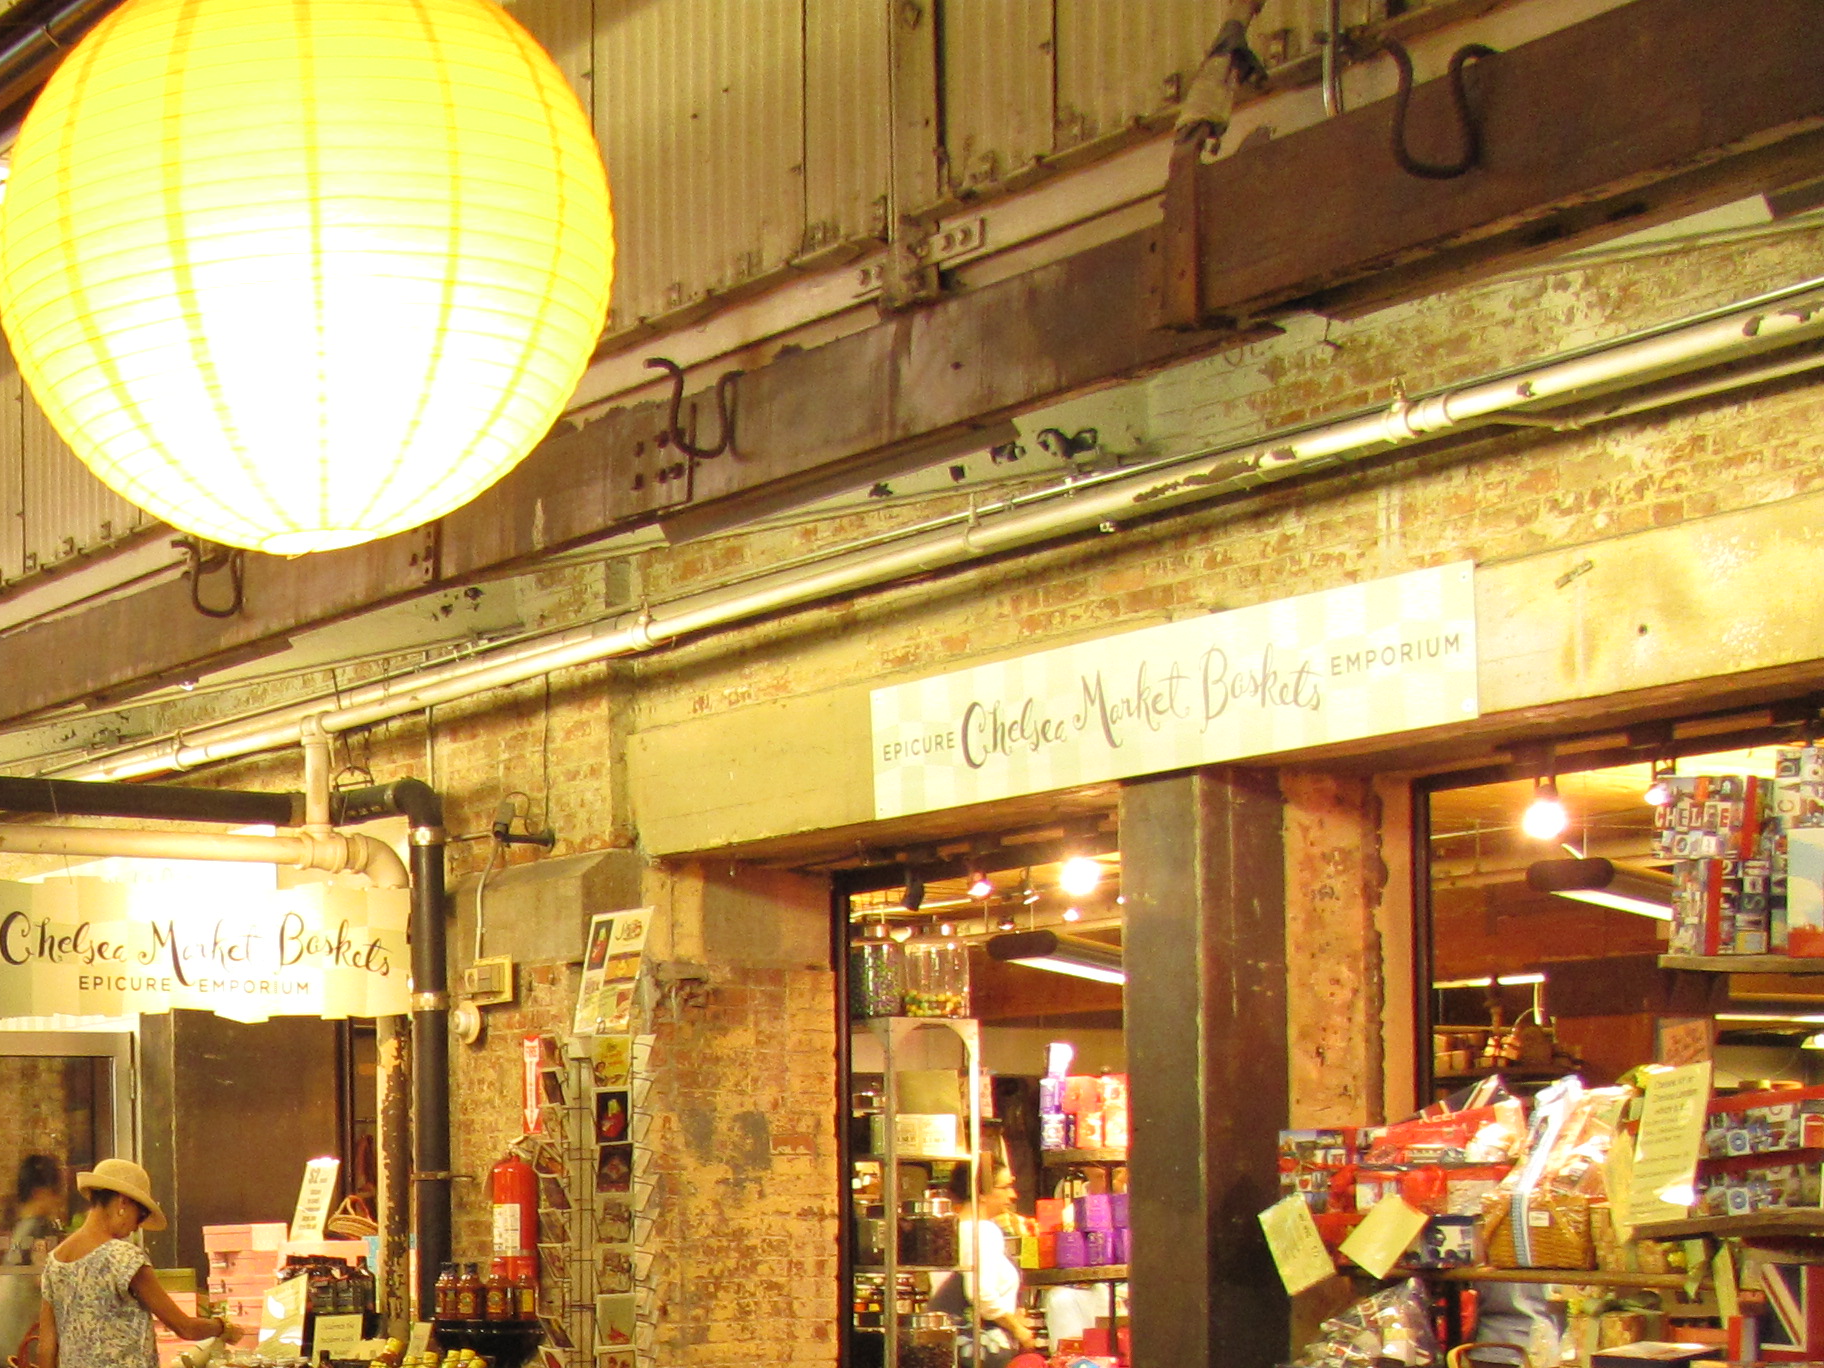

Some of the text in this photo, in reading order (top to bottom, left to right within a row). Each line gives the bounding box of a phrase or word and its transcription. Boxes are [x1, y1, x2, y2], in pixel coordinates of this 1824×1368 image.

[882, 634, 1461, 771] EPICURE Chelsea Market Baskets EMPORIUM
[78, 974, 311, 996] EPICURE EMPORIUM
[137, 914, 263, 987] Market
[277, 910, 393, 978] Baskets
